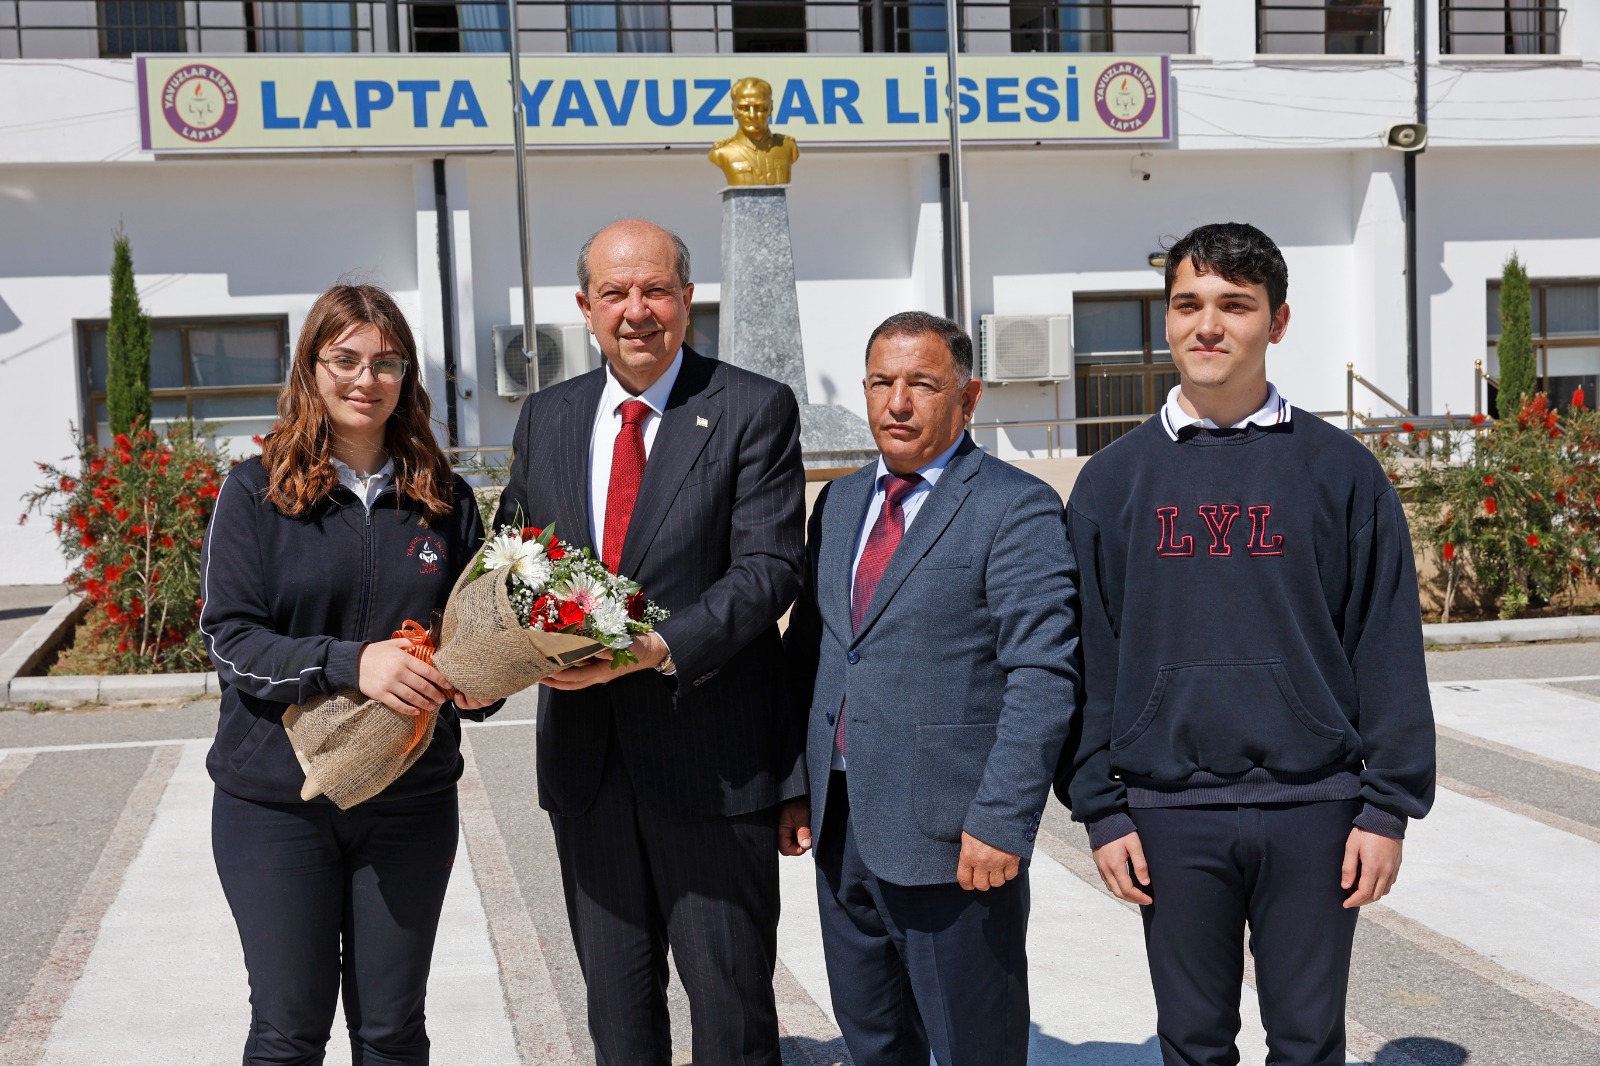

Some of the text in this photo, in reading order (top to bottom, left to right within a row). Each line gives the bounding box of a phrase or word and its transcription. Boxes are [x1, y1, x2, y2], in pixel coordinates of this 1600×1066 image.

[164, 67, 207, 109] YAVUZLAR
[260, 66, 1080, 129] LAPTA YAVUZAR LİSESİ
[1097, 64, 1132, 102] YAVUZLAR
[182, 127, 222, 140] LAPTA
[1110, 118, 1143, 130] LAPTA
[1156, 504, 1285, 557] LYL
